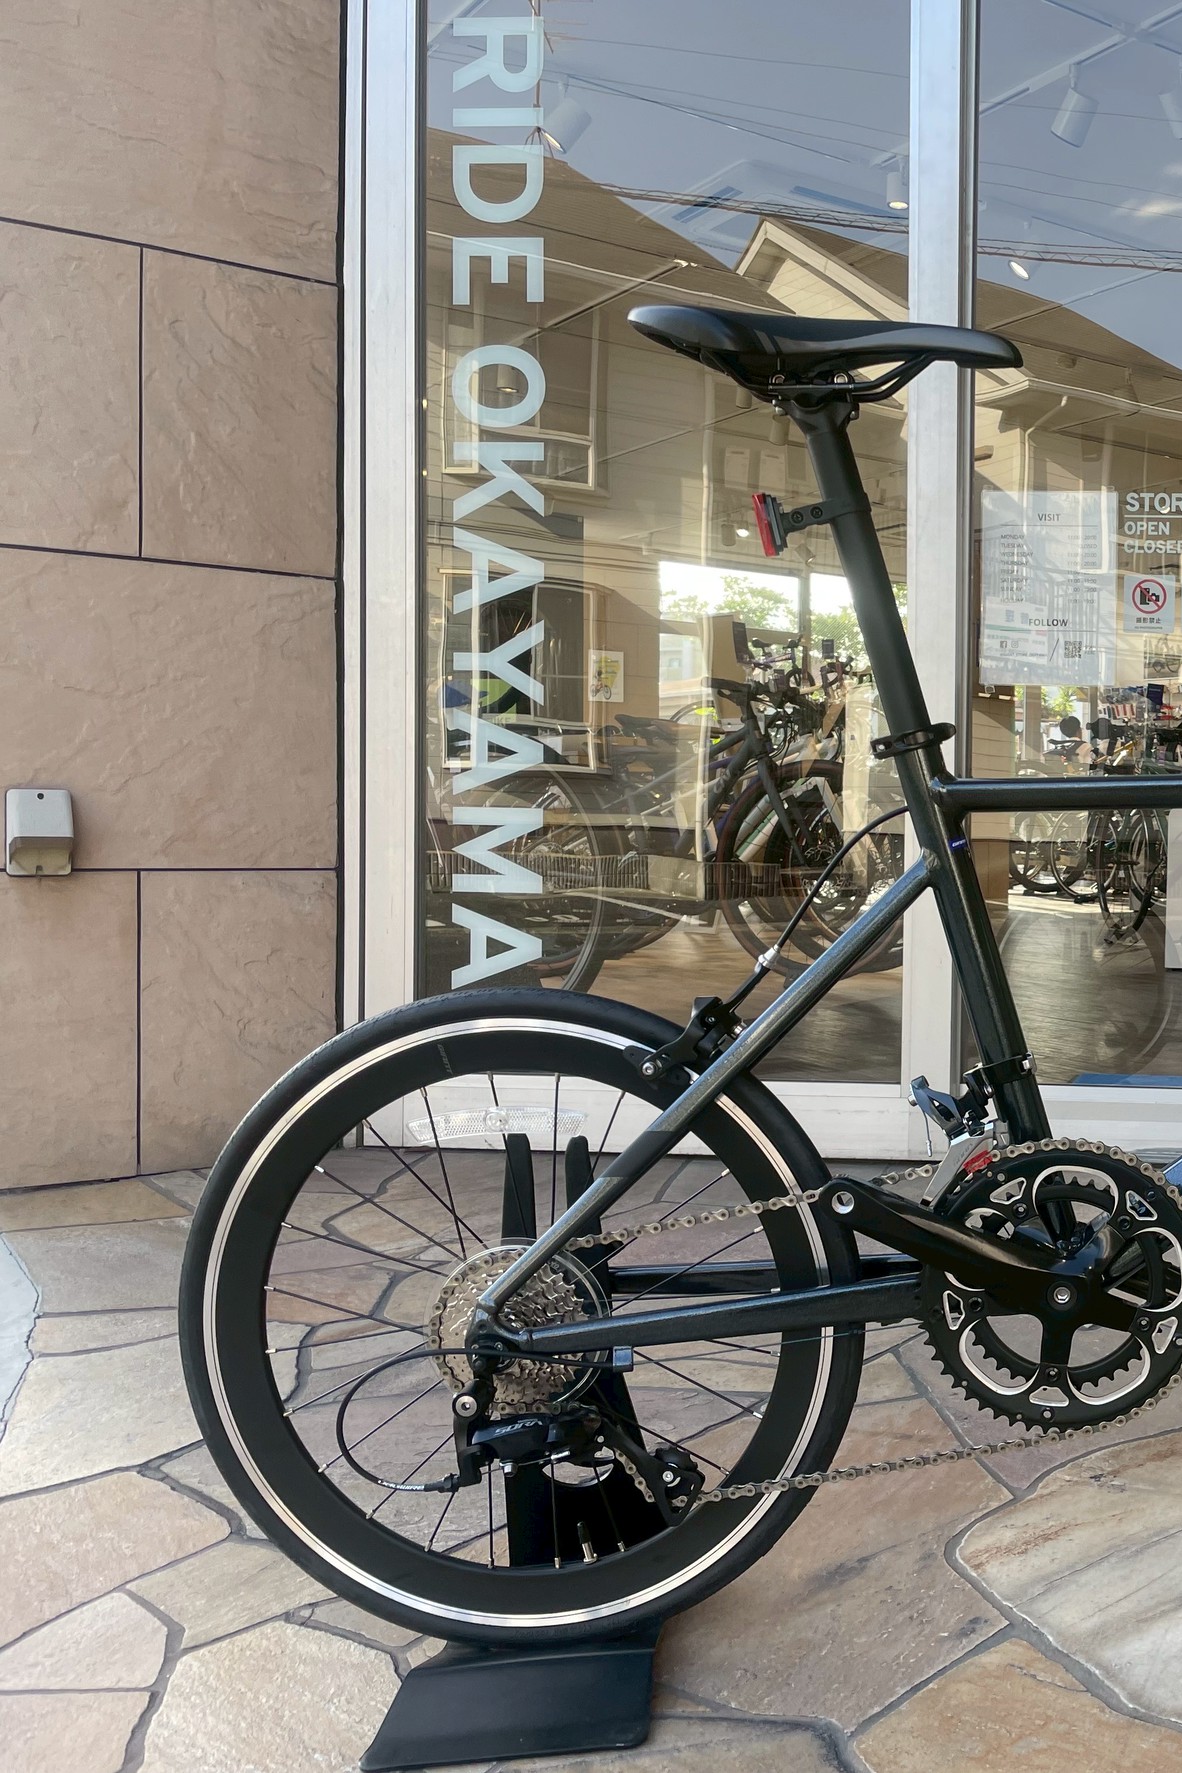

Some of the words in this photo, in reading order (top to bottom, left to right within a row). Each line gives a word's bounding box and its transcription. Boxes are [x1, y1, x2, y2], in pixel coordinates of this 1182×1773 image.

[453, 17, 544, 305] RIDE
[1037, 513, 1061, 522] VISIT
[1123, 521, 1170, 535] OPEN
[1028, 618, 1068, 627] FOLLOW
[451, 345, 545, 990] OKAYAMA
